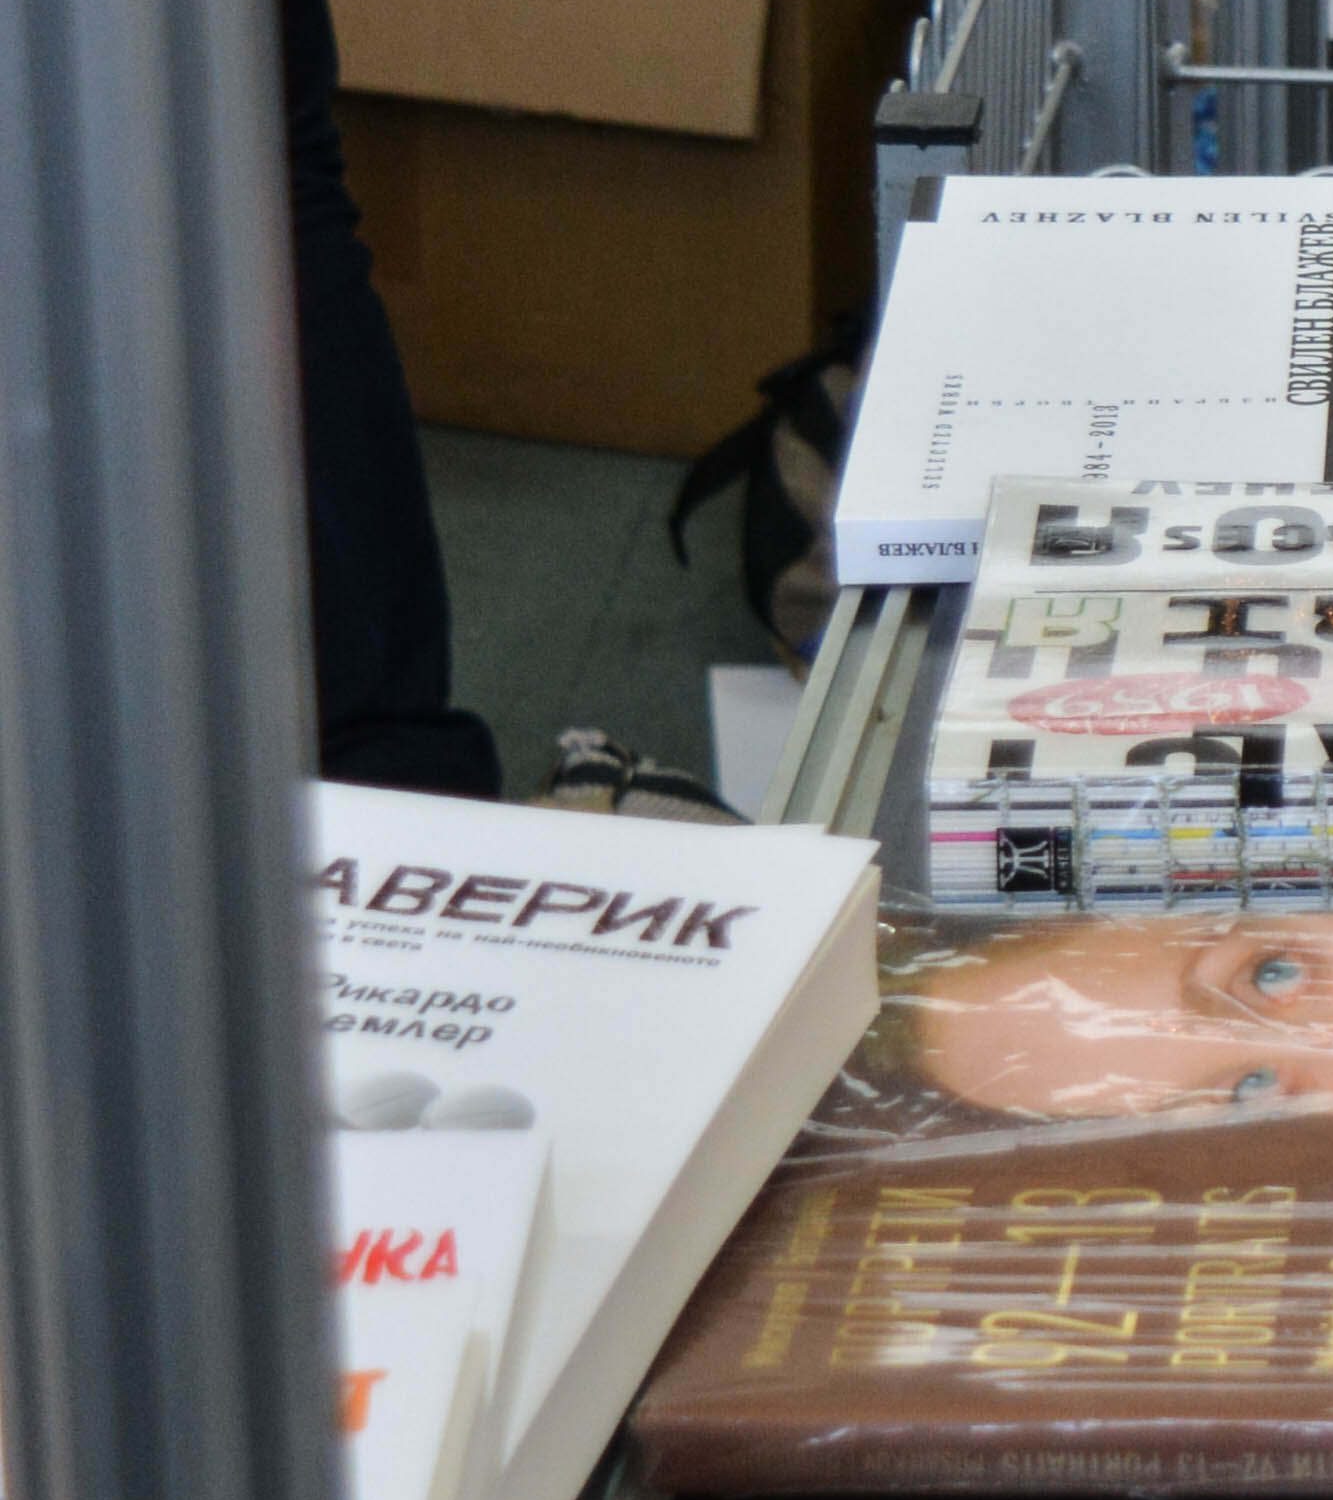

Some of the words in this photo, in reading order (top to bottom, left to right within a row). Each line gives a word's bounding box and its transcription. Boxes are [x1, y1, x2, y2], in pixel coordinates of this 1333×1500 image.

[981, 212, 1174, 224] BLAZHEV
[1286, 316, 1333, 406] СВИЛЕН
[877, 542, 968, 558] БЛАЖЕВ
[828, 1187, 976, 1367] ПОРТРЕТИ
[1169, 1186, 1298, 1368] PORTRAITS
